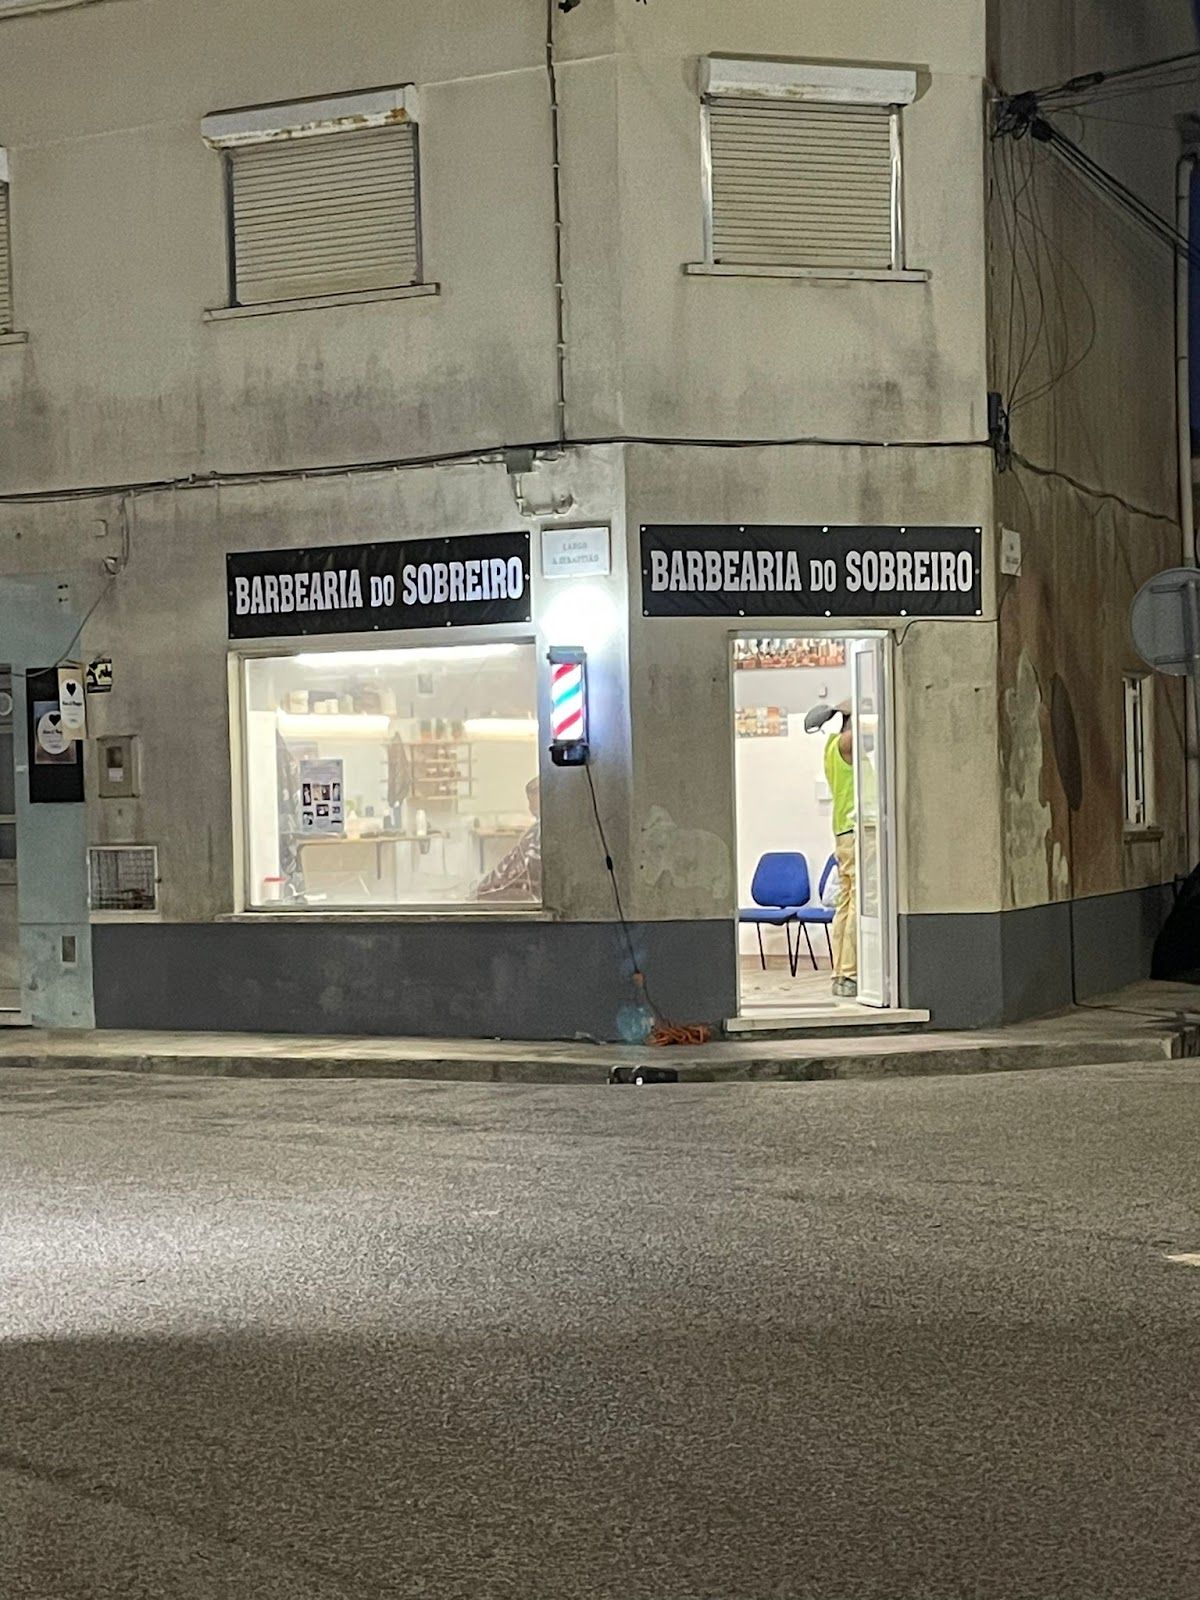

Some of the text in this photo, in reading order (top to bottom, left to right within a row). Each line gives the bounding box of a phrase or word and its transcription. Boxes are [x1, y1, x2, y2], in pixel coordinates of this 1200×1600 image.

[235, 556, 524, 615] BARBEARIA DO SOBREIRO
[650, 550, 973, 593] BARBEARIA DO SOBREIRO
